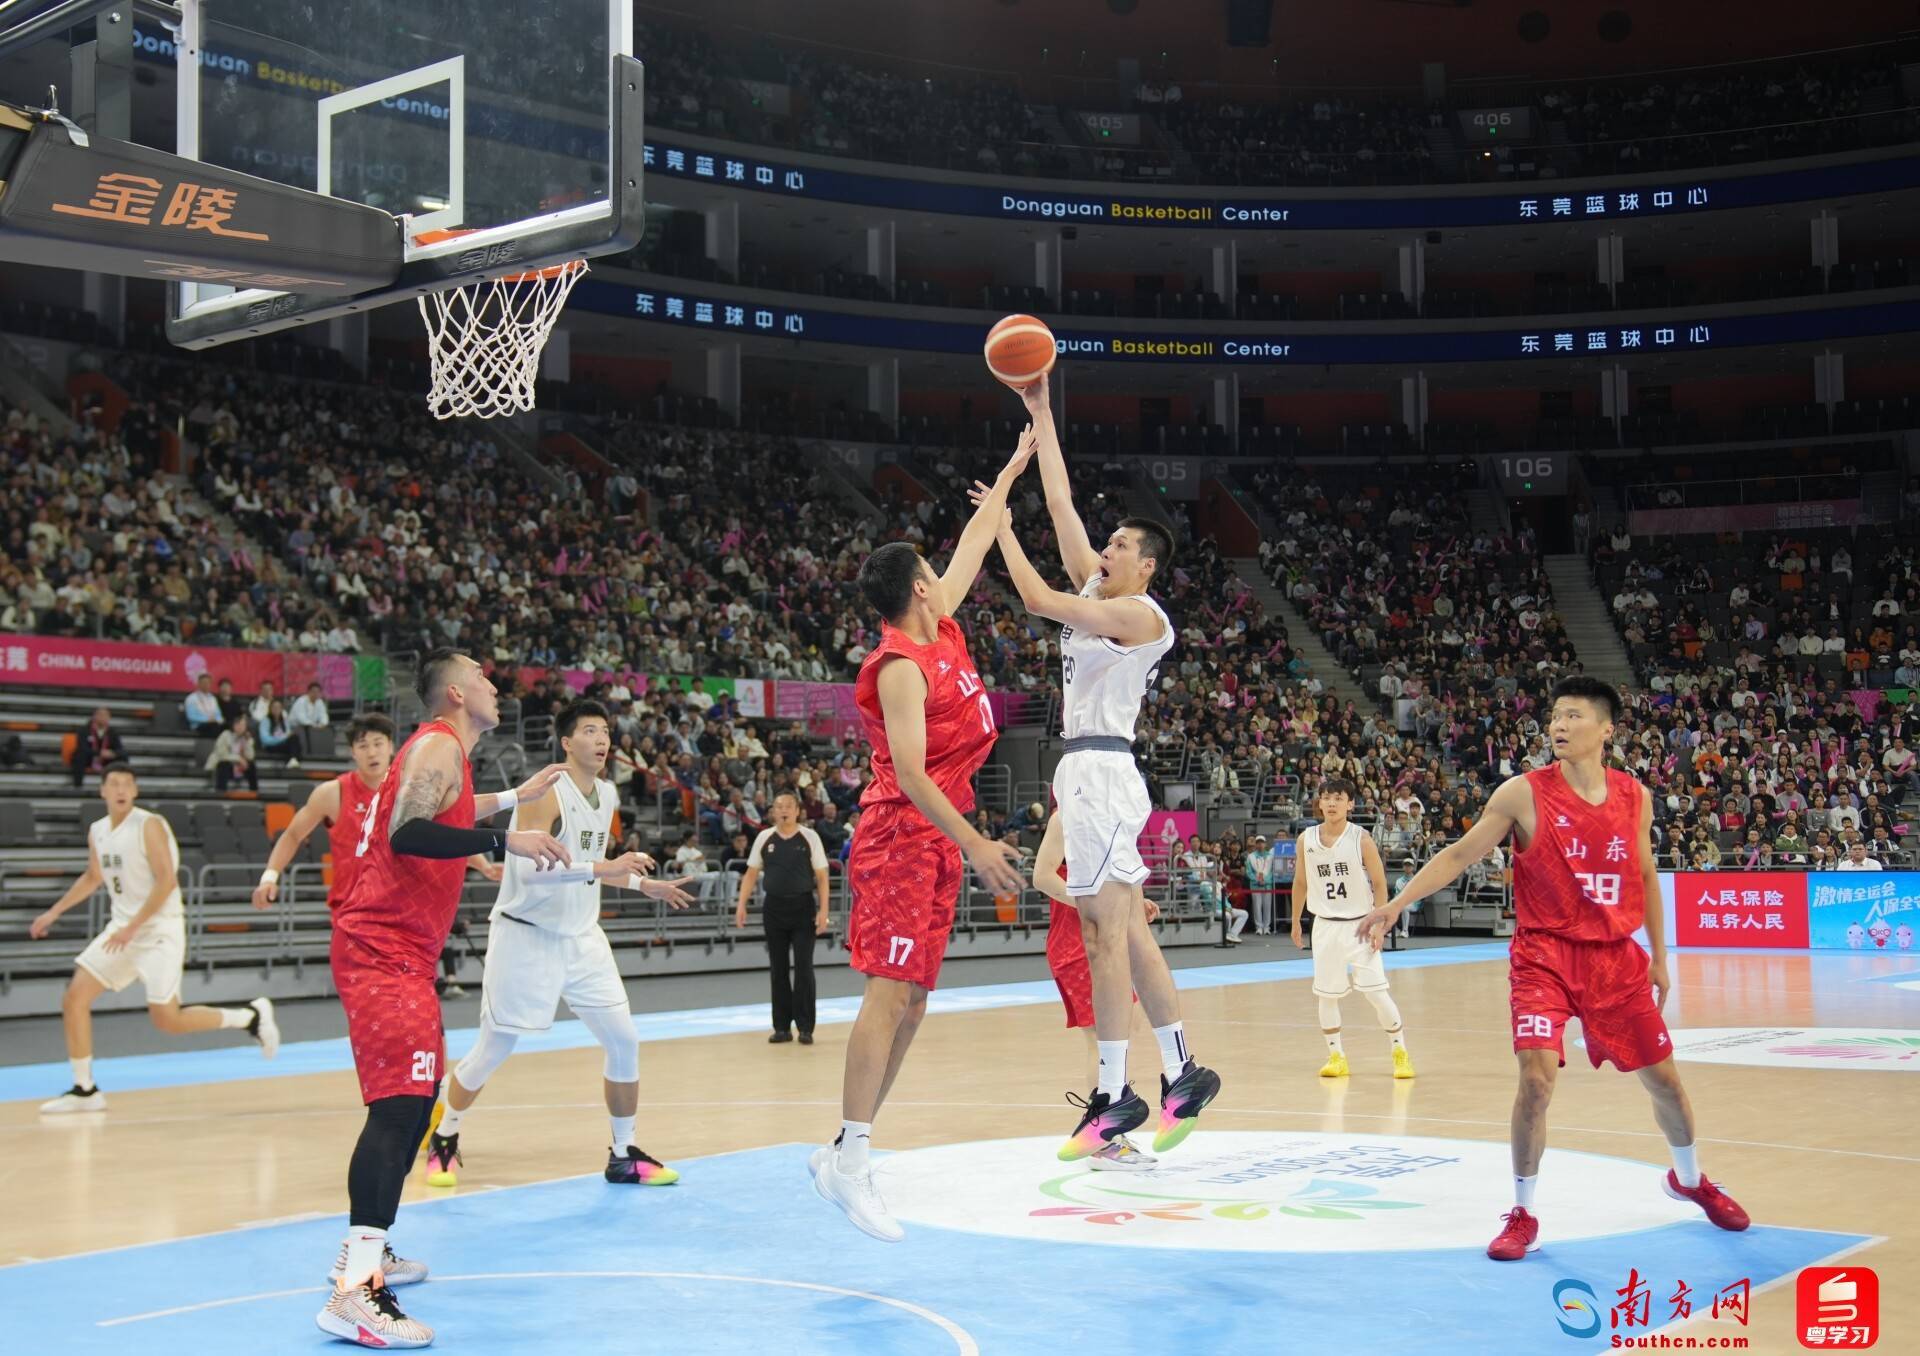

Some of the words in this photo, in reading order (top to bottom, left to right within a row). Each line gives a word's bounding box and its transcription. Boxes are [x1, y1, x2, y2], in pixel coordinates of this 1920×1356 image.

[132, 28, 249, 75] Donuan
[1473, 112, 1512, 127] 406
[643, 145, 804, 190] 东莞篮球中心
[52, 172, 269, 241] 金陵
[1002, 195, 1104, 217] Dongguan
[1111, 203, 1212, 221] Basketball
[1222, 206, 1290, 221] Center
[1519, 186, 1708, 217] 东莞篮球中心
[636, 292, 804, 333] 东莞篮球中心
[1055, 339, 1105, 356] guan
[1112, 339, 1213, 356] Basketball
[1223, 342, 1291, 357] Center
[1520, 325, 1710, 353] 东莞篮球中心
[1501, 457, 1553, 478] 106
[38, 653, 85, 669] CHINA
[91, 656, 172, 674] DONGGUAN
[1564, 835, 1628, 862] 山东
[1316, 862, 1349, 878] 廣東
[1325, 881, 1347, 900] 24
[1574, 872, 1621, 905] 28
[1697, 889, 1785, 907] 人民保险
[1812, 880, 1897, 908] 激情全运会
[1698, 913, 1785, 930] 服务人民
[888, 935, 914, 966] 17
[1516, 1014, 1553, 1038] 28
[412, 1050, 436, 1081] 20
